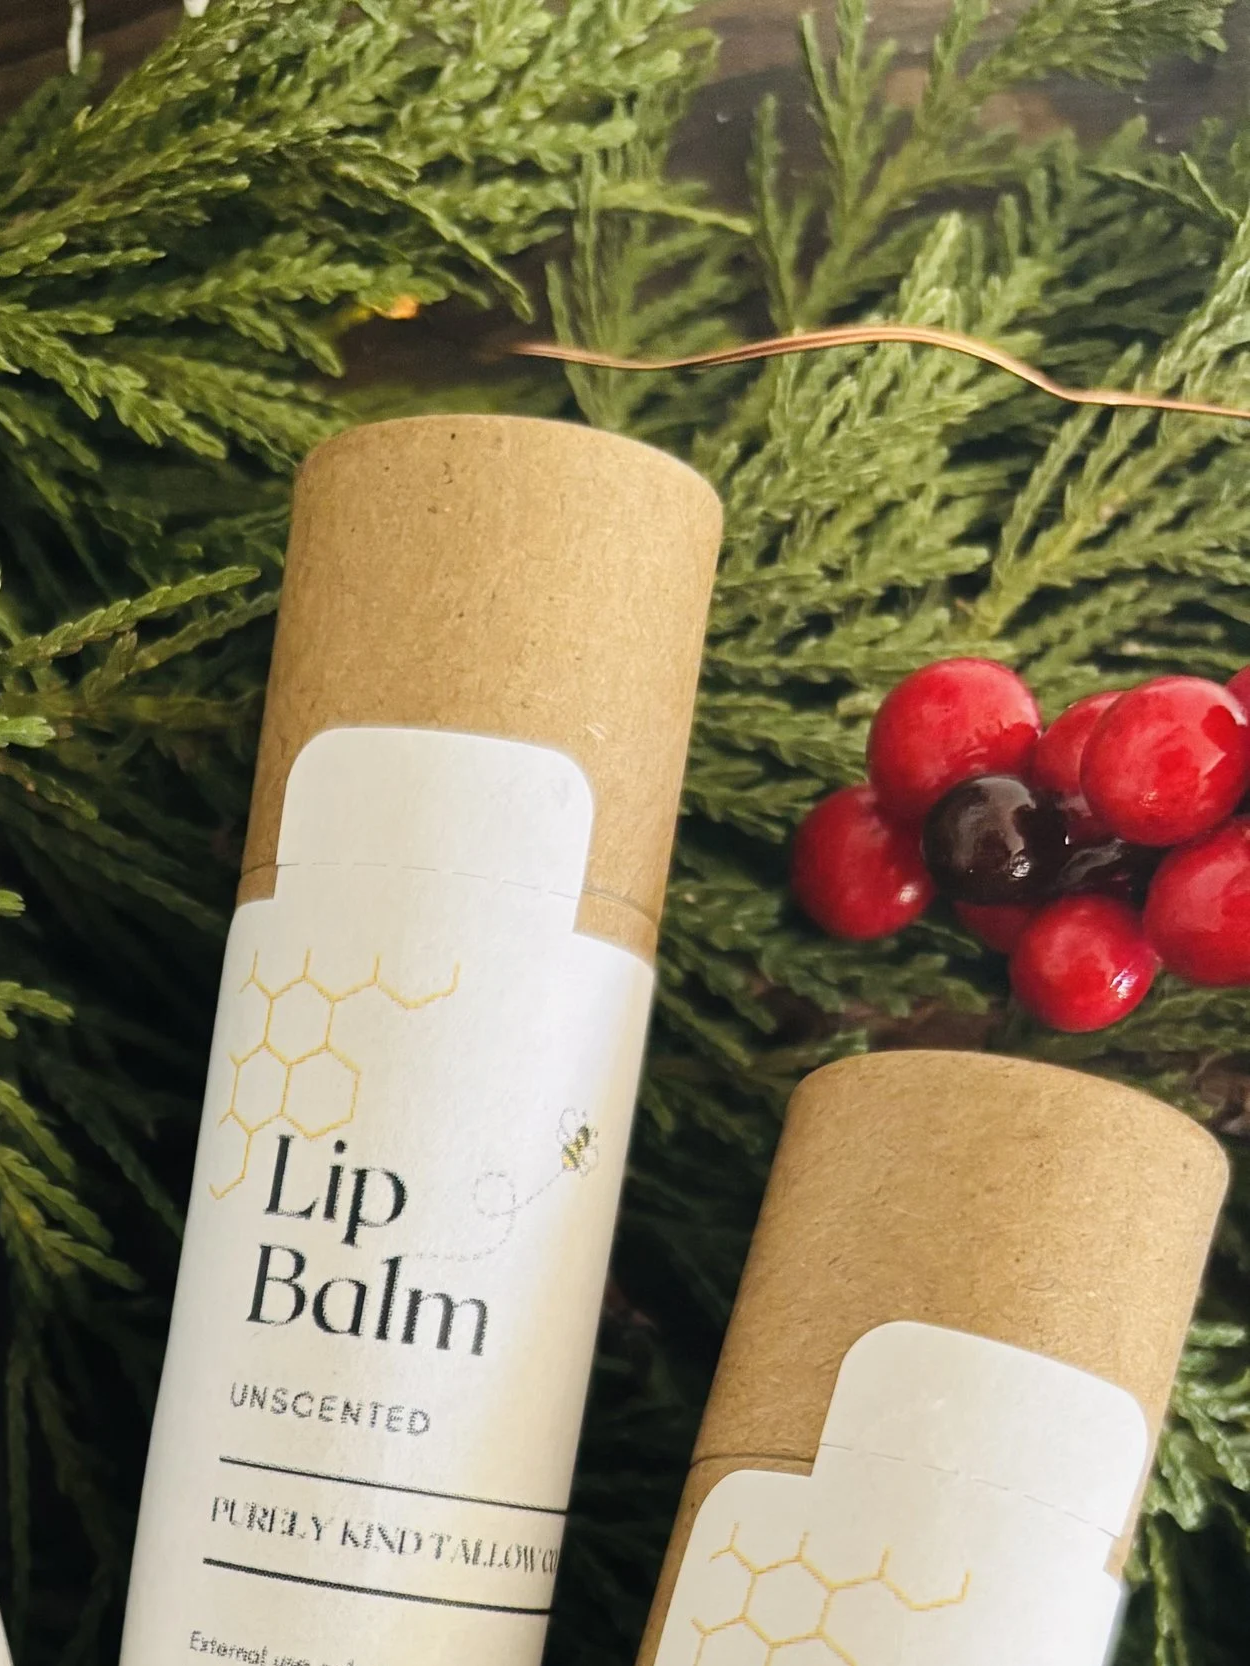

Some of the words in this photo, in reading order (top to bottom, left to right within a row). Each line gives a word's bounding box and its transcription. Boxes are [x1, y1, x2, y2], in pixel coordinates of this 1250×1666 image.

[262, 1134, 408, 1248] Lip
[246, 1244, 489, 1357] Balm
[229, 1382, 431, 1436] UNSCENTED
[210, 1496, 335, 1542] PURELY
[340, 1520, 423, 1557] KIND
[430, 1532, 542, 1573] TALLOW
[189, 1630, 267, 1666] External
